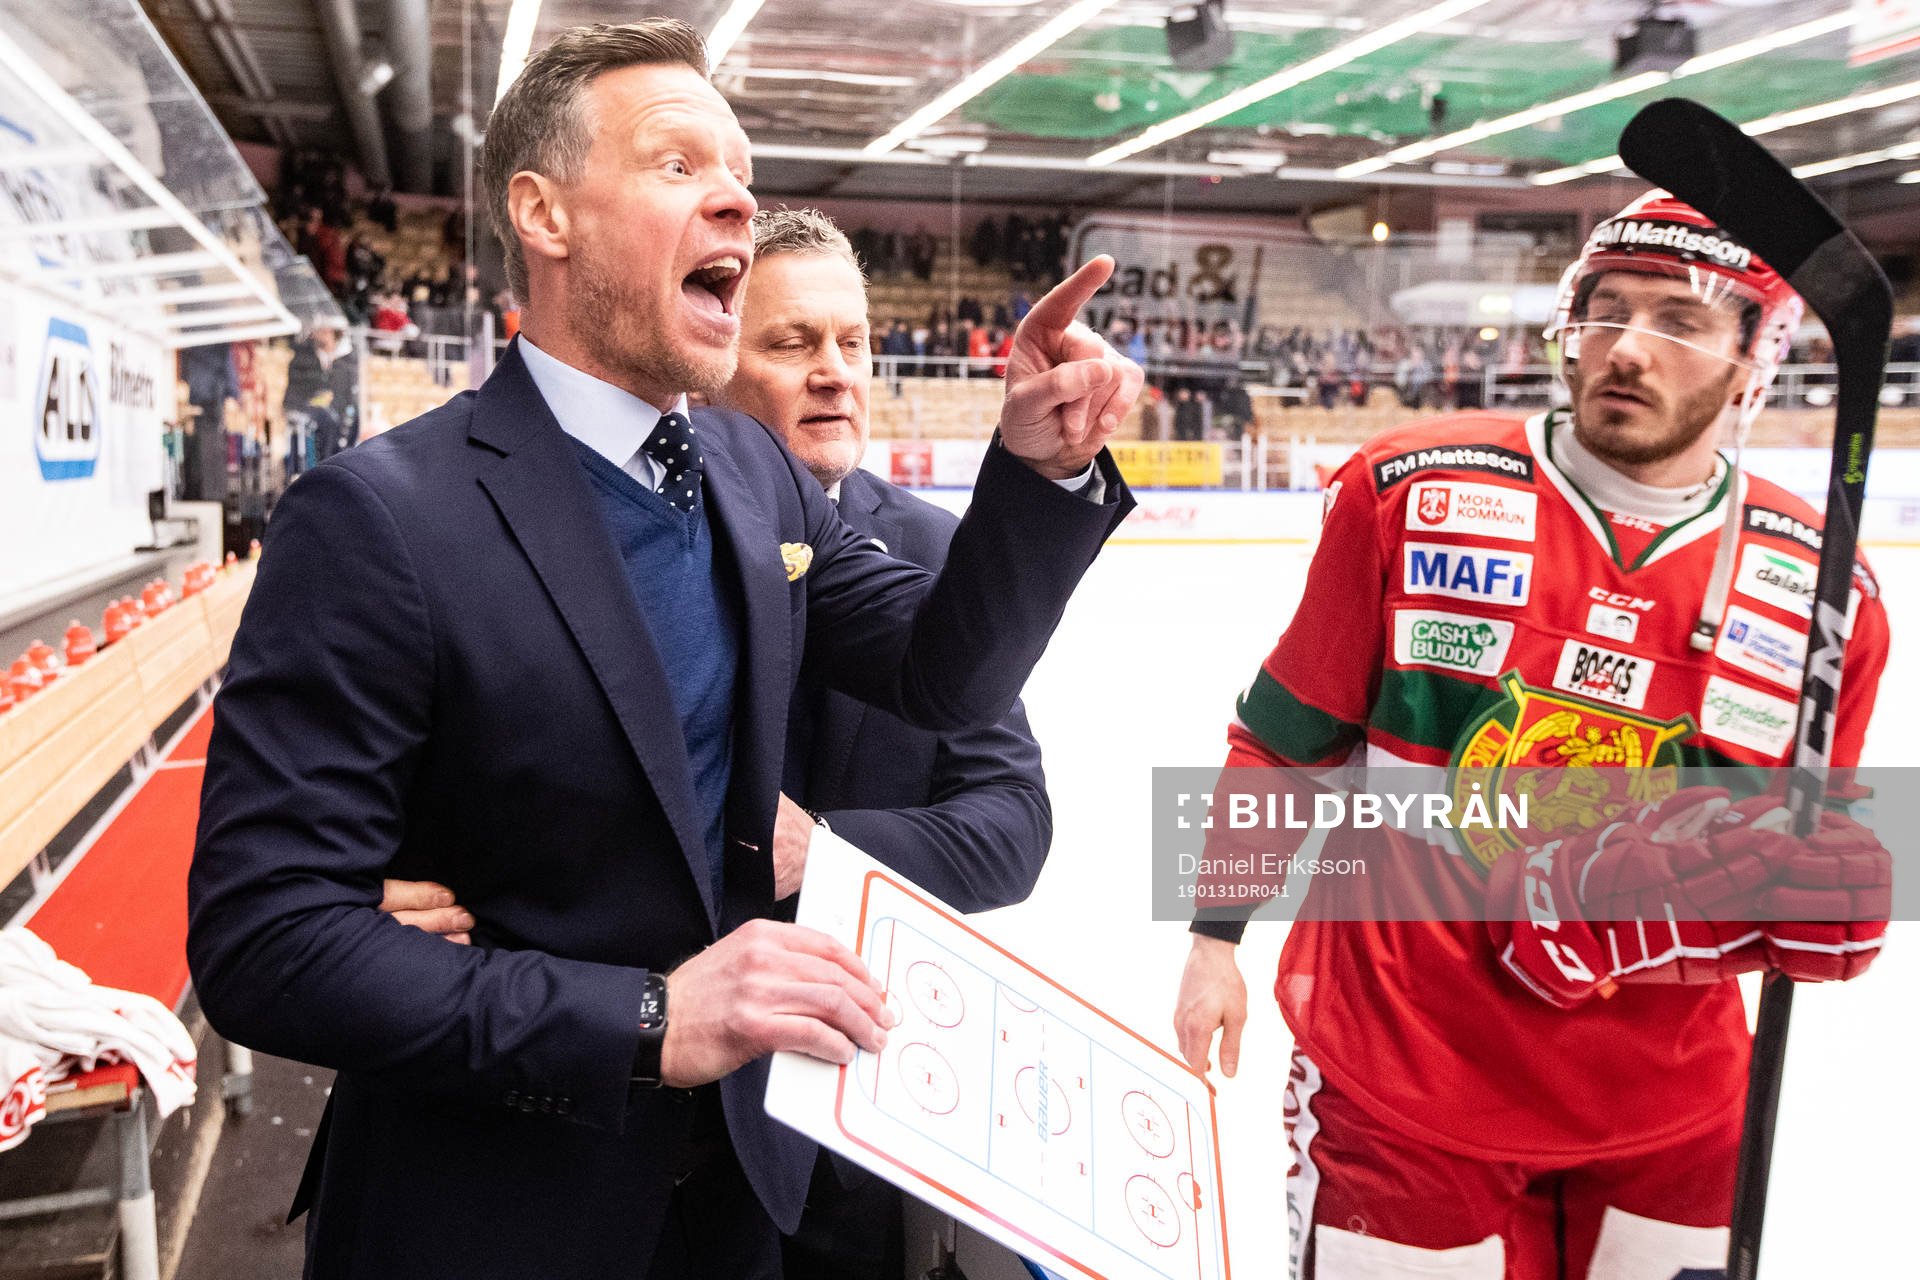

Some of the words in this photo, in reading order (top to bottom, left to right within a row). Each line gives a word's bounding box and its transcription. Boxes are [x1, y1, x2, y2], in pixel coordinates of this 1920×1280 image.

[1621, 222, 1751, 268] Mattsson
[1187, 243, 1236, 303] &
[1380, 455, 1417, 483] FM
[1418, 449, 1528, 476] Mattsson
[1457, 494, 1504, 508] MORA
[1456, 507, 1526, 525] KOMMUN
[1749, 509, 1793, 535] FM
[1588, 586, 1656, 612] CCM
[1413, 621, 1469, 646] CASH
[1411, 639, 1482, 669] BUDDY
